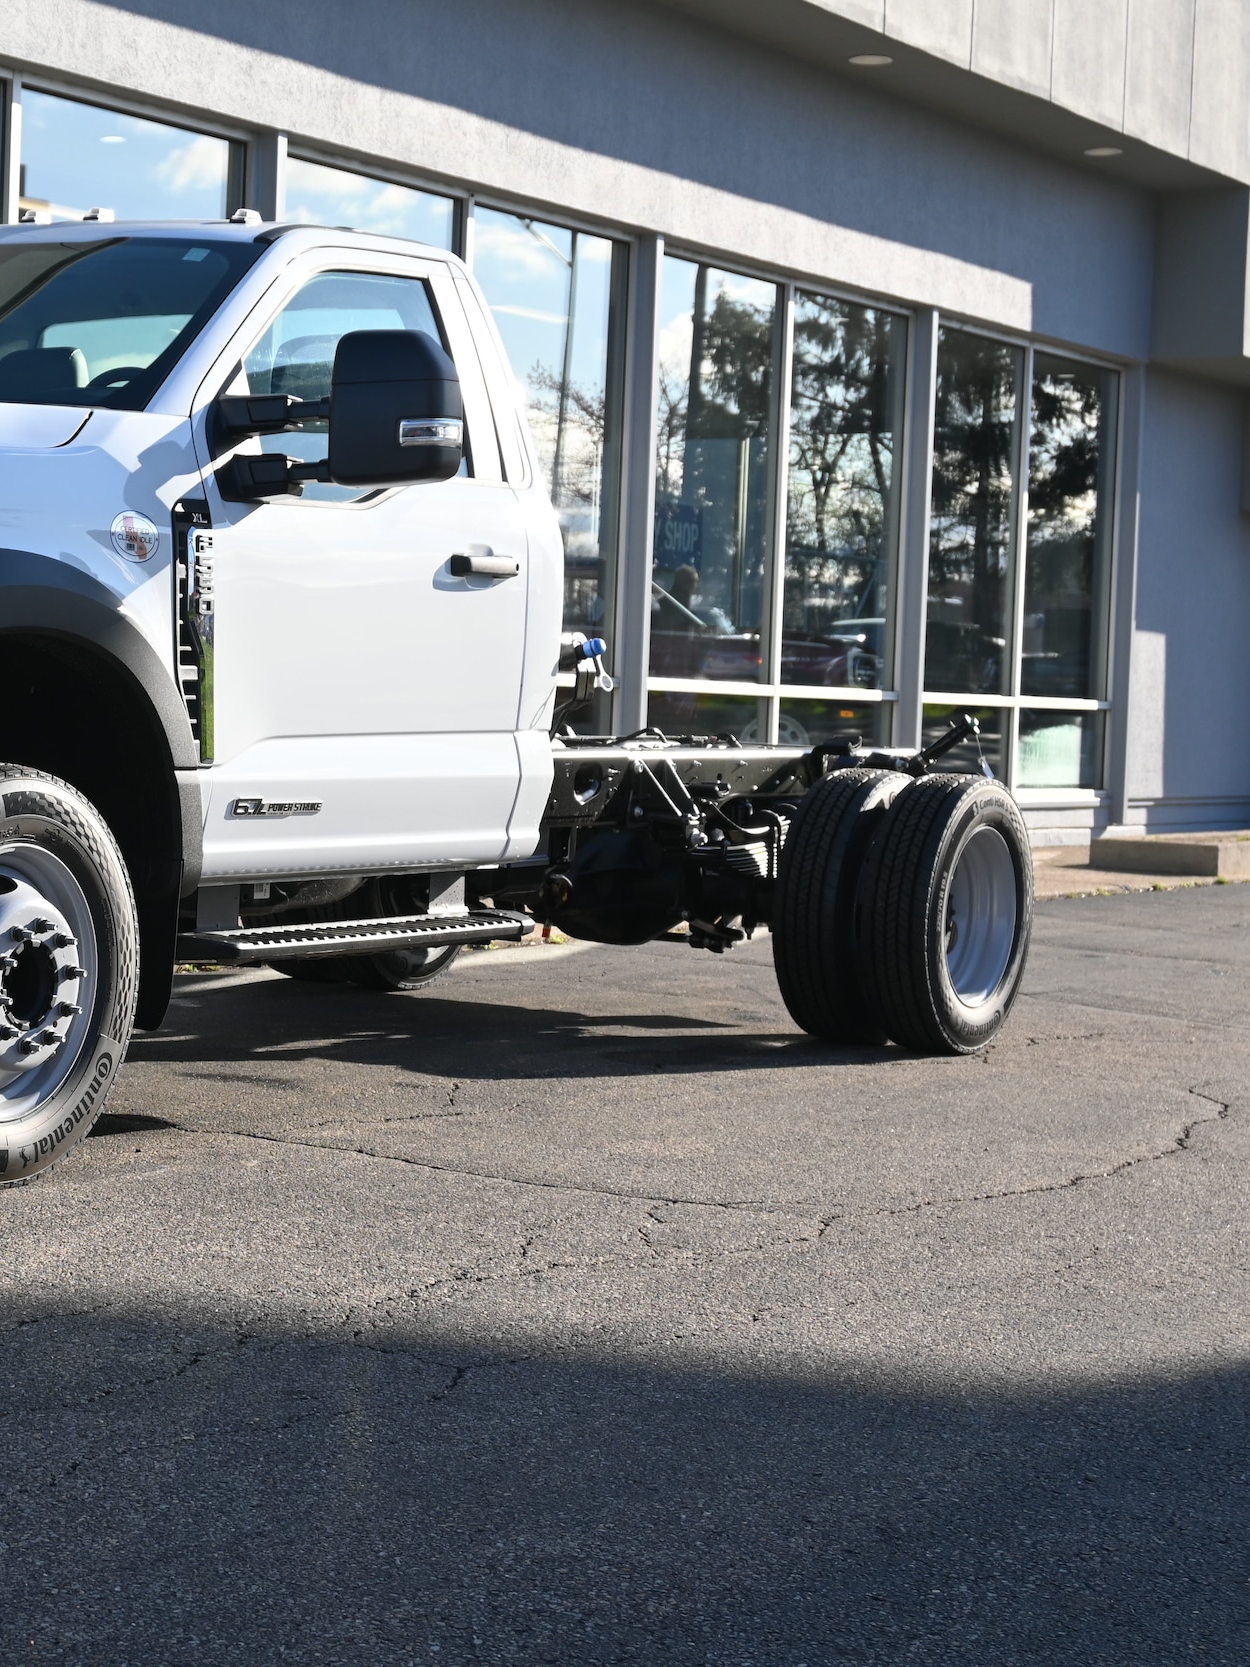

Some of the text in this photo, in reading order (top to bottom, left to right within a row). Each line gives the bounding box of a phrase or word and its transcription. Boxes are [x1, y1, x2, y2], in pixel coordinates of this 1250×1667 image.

[191, 512, 208, 523] XL
[117, 533, 137, 543] CLEAN
[664, 520, 699, 552] SHOP
[233, 798, 322, 815] 6.7L POWER STROKE
[32, 1052, 113, 1163] Continental
